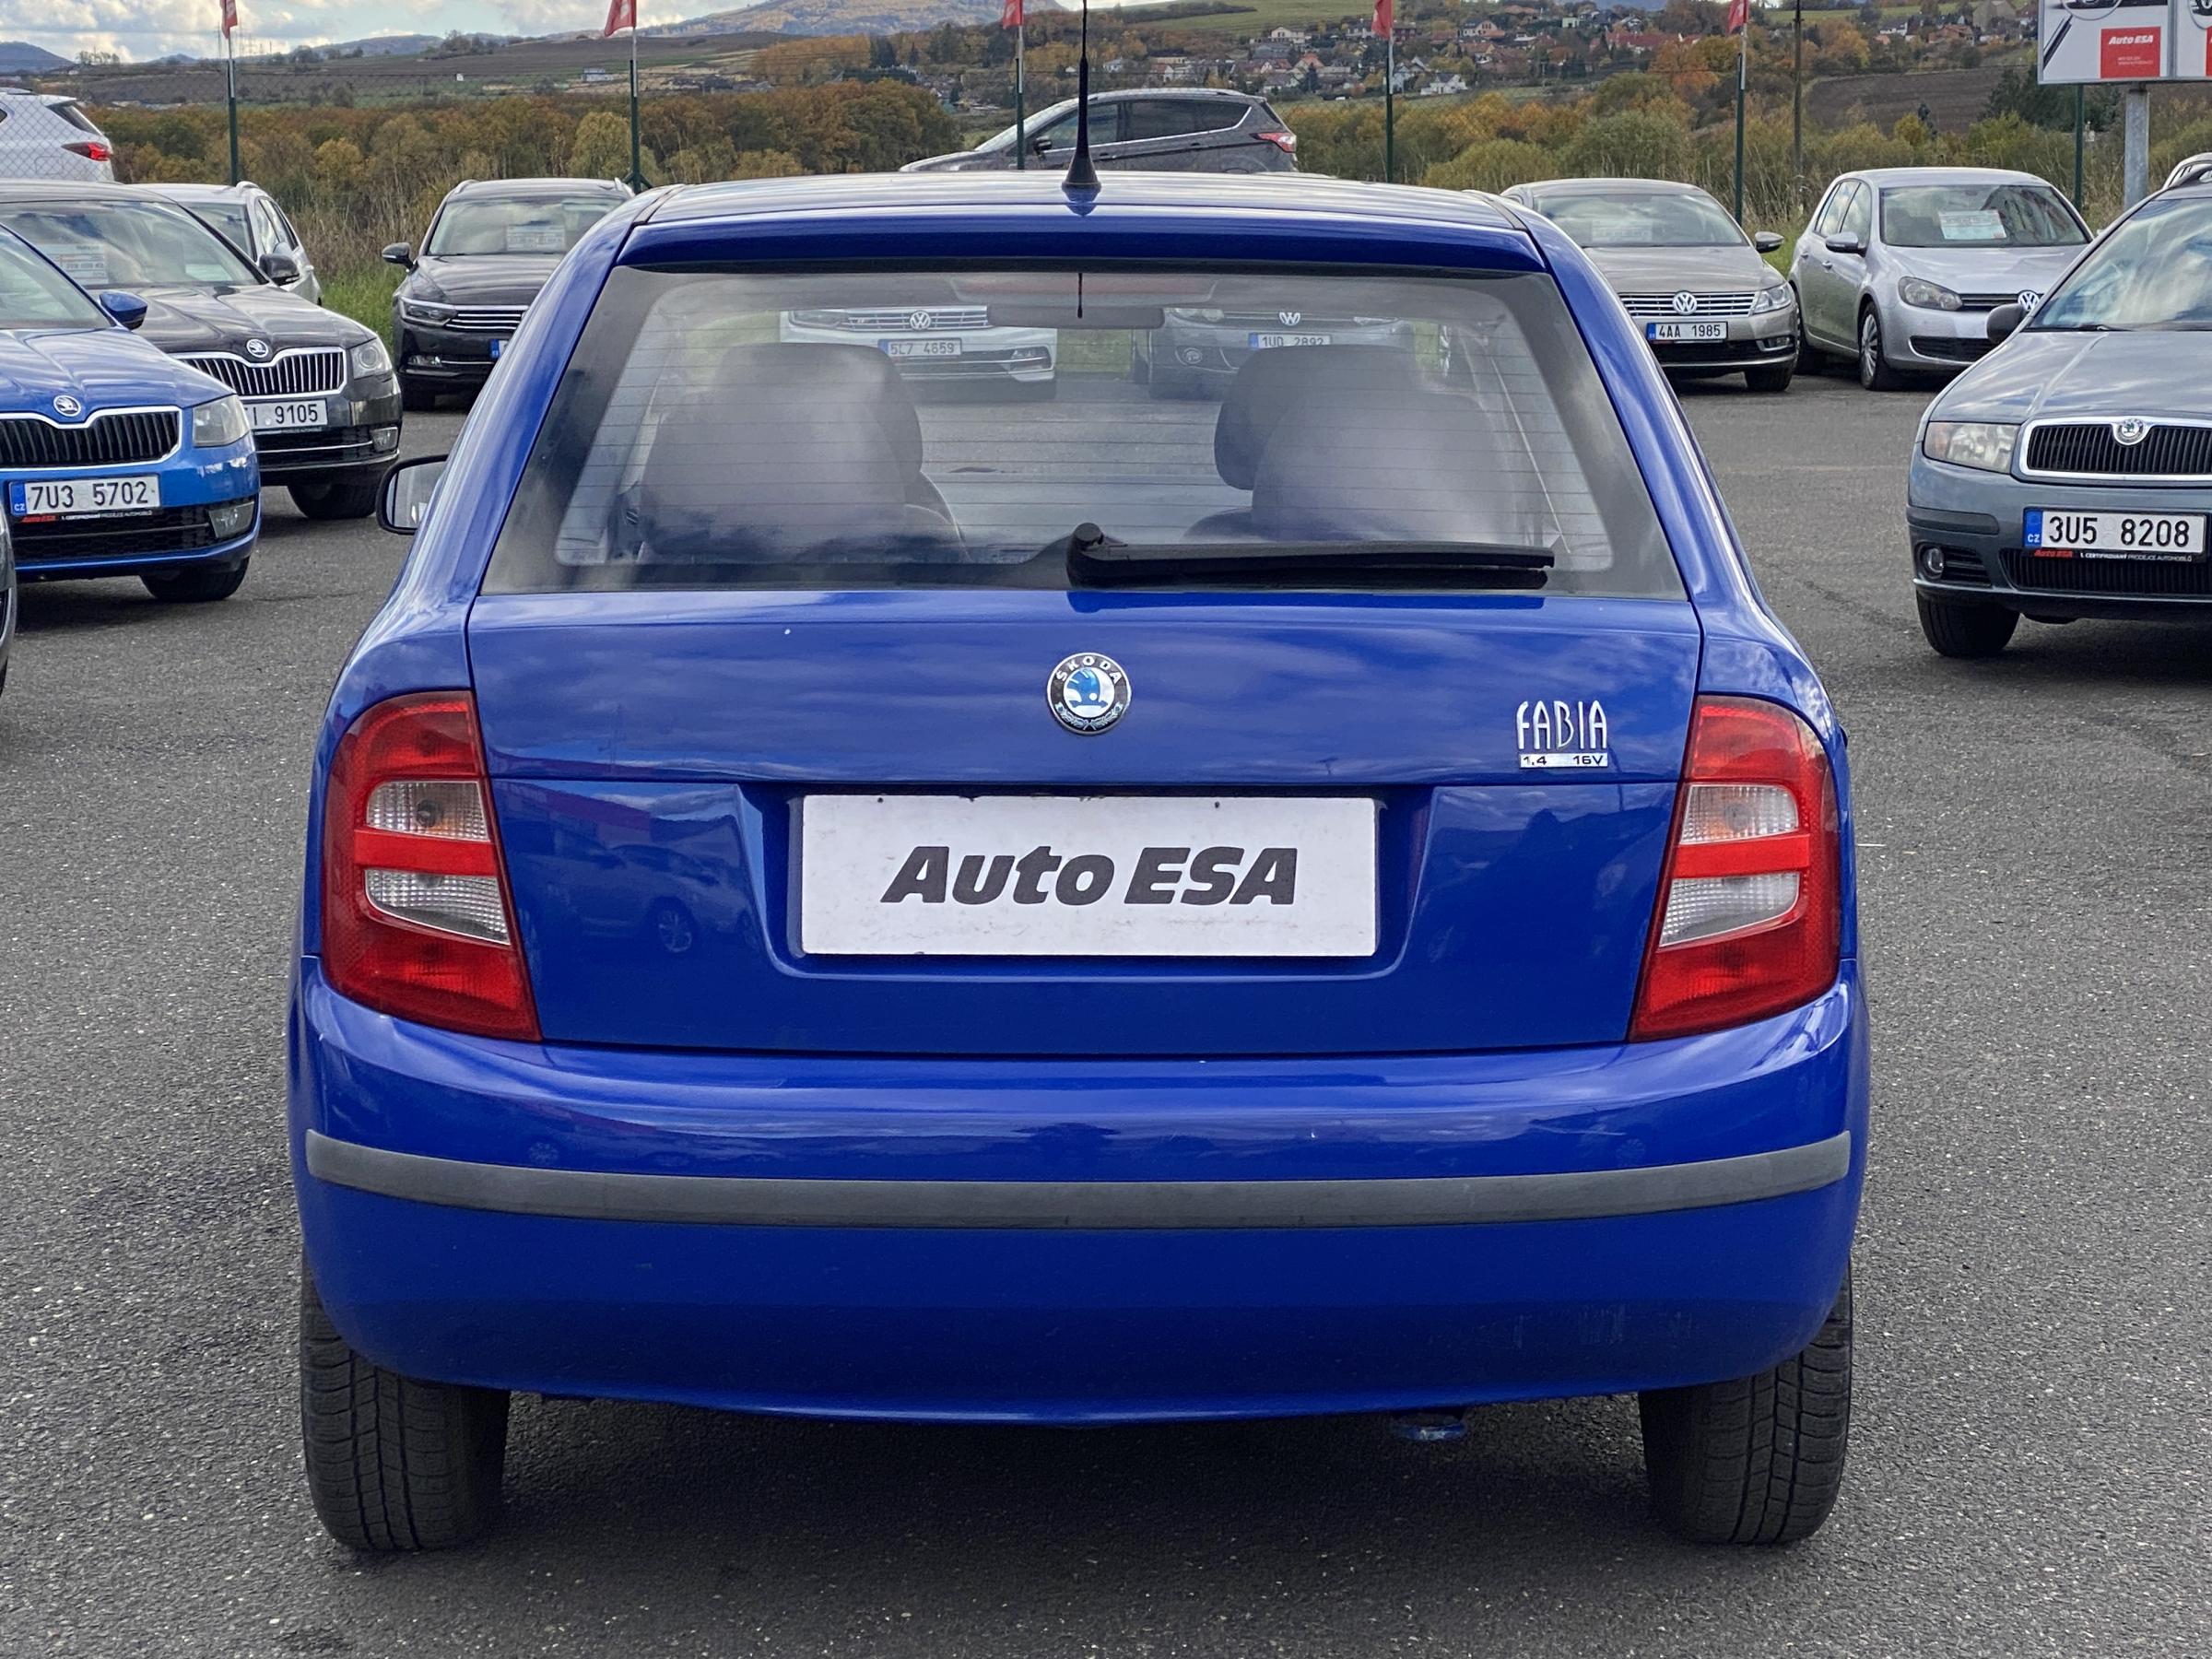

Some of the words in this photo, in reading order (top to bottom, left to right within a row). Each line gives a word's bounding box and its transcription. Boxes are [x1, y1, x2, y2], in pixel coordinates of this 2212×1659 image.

[2135, 35, 2153, 43] ESA
[1659, 325, 1681, 337] 4AA
[1691, 324, 1721, 337] 1985
[890, 343, 913, 355] 5L7
[275, 404, 318, 424] 9105
[31, 485, 74, 511] 7U3
[92, 481, 148, 506] 5702
[2028, 534, 2040, 543] CZ
[2049, 516, 2098, 544] 3U5
[2121, 518, 2190, 547] 8208
[1516, 700, 1607, 750] FABIA
[1524, 756, 1547, 766] 1.4
[1573, 755, 1604, 765] 16V
[879, 845, 1114, 906] Auto
[1124, 846, 1298, 906] ESA
